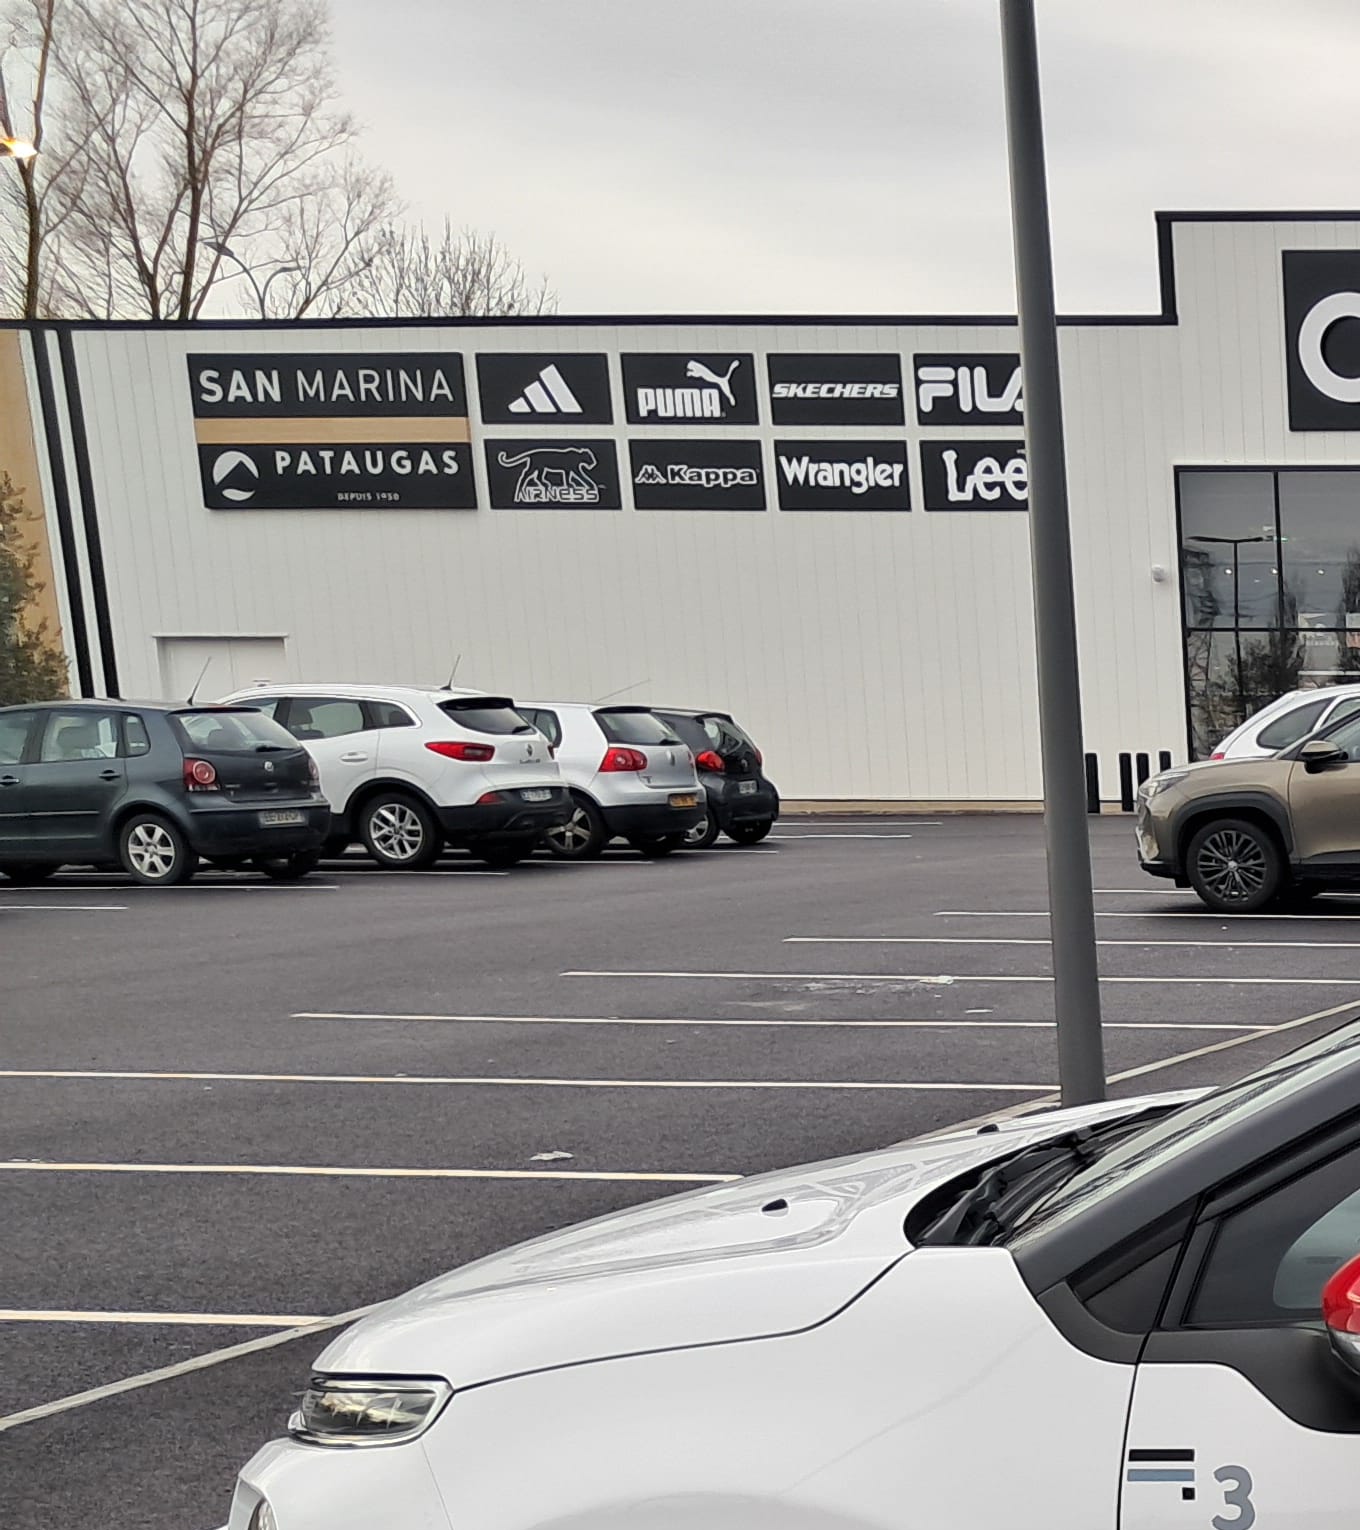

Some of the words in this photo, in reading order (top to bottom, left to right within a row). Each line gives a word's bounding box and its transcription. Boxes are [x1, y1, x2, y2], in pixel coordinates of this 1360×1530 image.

[199, 369, 282, 403] SAN
[296, 369, 455, 402] MARINA
[772, 383, 899, 398] SKECHERS
[637, 388, 721, 417] PUMA
[273, 450, 460, 475] PATAUGAS
[668, 465, 758, 488] Kappa
[778, 456, 904, 495] Wrangler
[941, 450, 1029, 502] Lee
